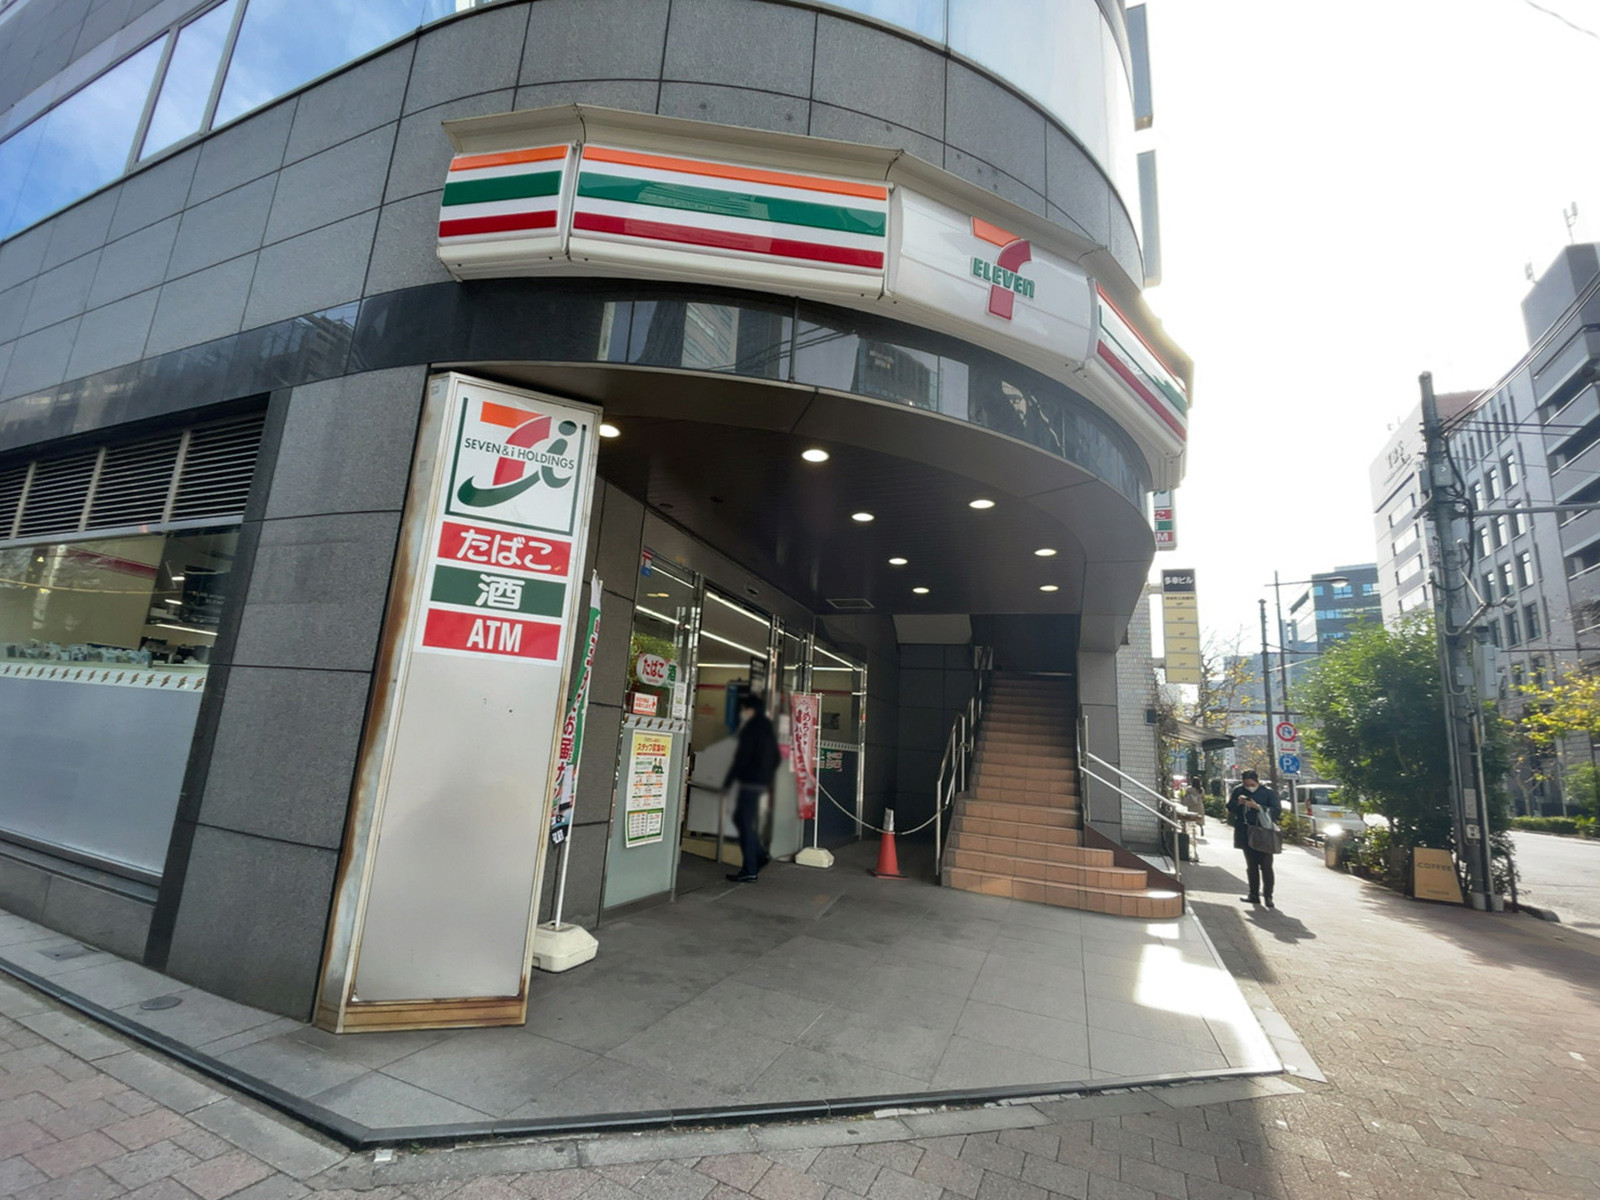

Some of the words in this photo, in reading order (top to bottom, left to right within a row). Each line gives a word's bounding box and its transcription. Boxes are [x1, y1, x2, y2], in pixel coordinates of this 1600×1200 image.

[972, 257, 1035, 299] ELEVEN
[517, 448, 575, 470] HOLDINGS
[456, 528, 553, 571] たばこ
[474, 572, 525, 610] 酒
[466, 618, 523, 653] ATM
[642, 658, 665, 679] たばこ
[1417, 862, 1452, 872] COFFEE
